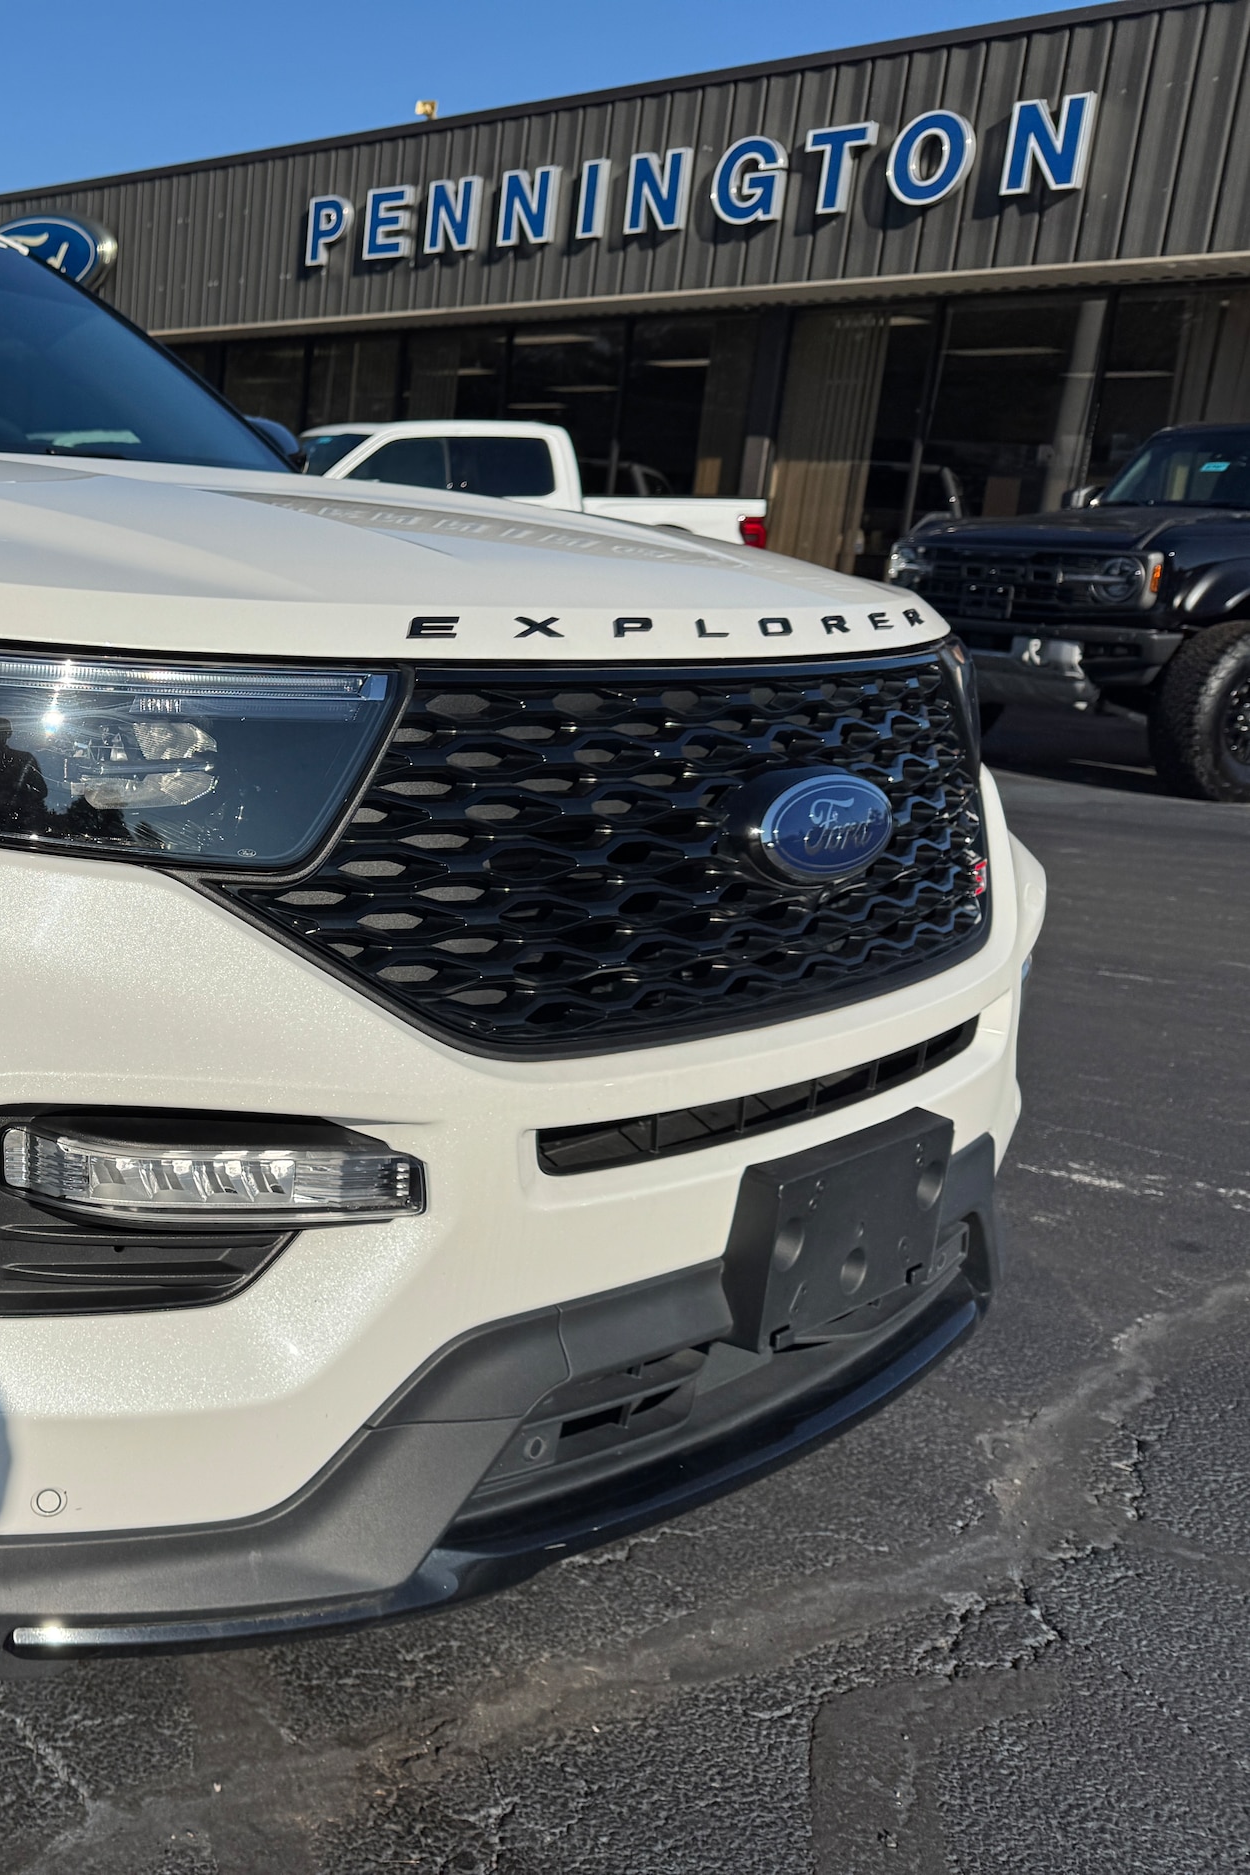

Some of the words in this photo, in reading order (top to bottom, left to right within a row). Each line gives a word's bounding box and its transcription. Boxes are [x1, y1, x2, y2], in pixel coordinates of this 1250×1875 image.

[305, 91, 1098, 266] PENNINGTON
[405, 608, 926, 639] EXPLORER
[804, 797, 875, 856] Ford
